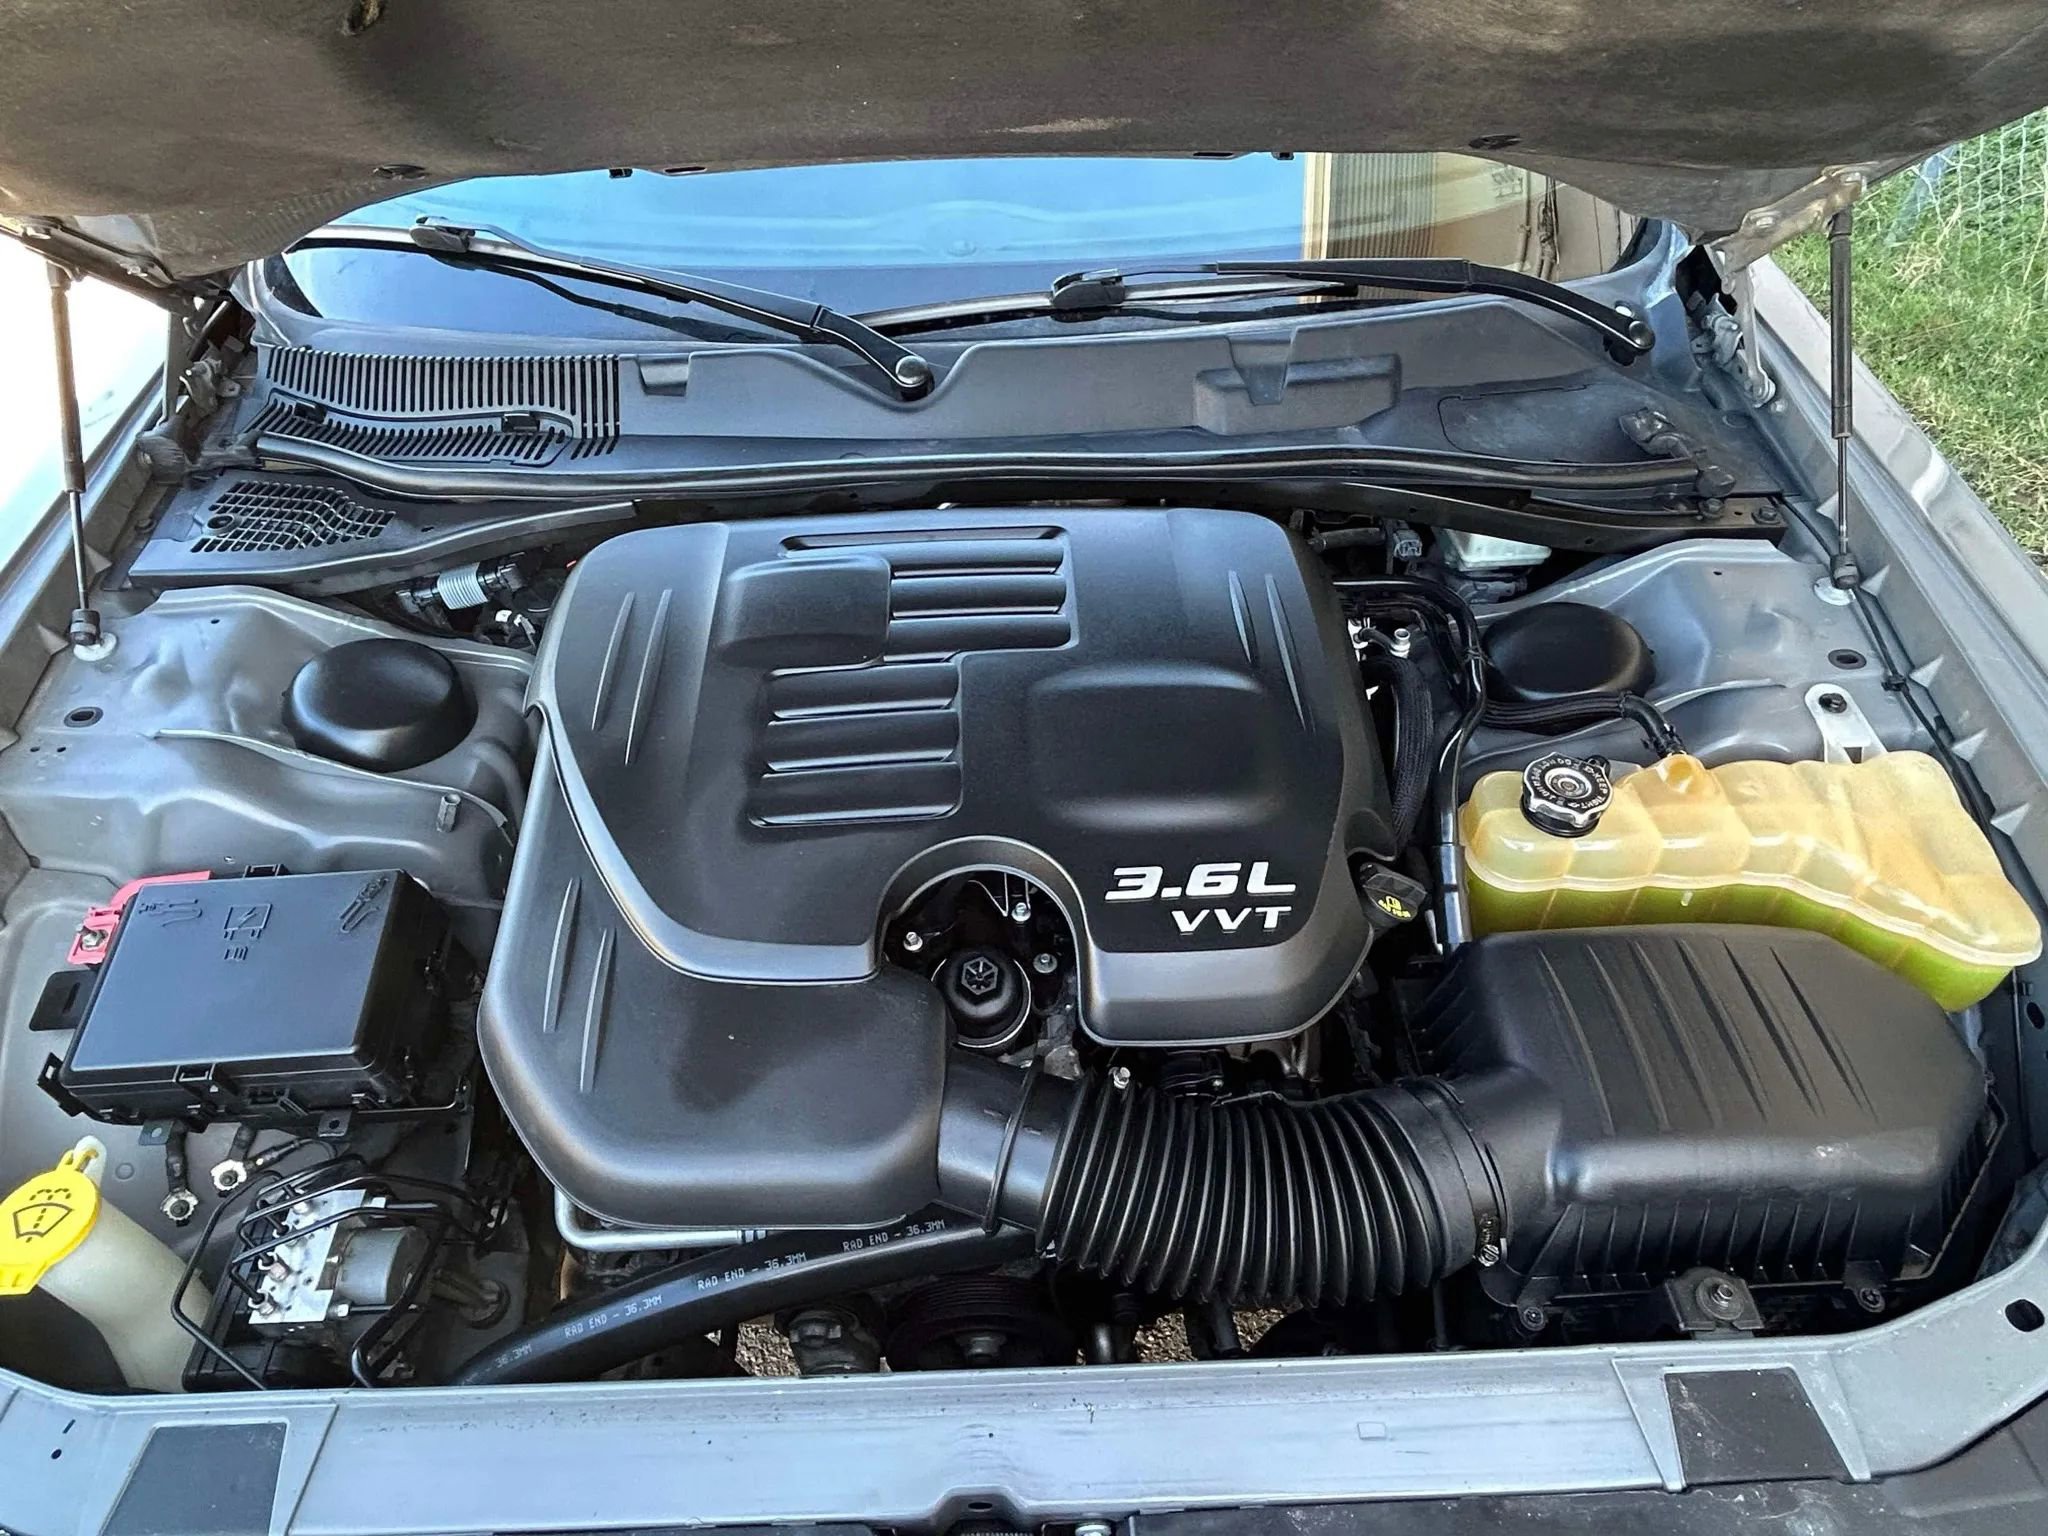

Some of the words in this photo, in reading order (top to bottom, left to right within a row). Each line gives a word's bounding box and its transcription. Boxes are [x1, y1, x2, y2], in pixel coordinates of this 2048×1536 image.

[1593, 771, 1609, 794] KEEP
[1580, 795, 1607, 809] TIGHT
[1104, 861, 1296, 903] 3.6L
[1171, 906, 1292, 935] VVT
[843, 1239, 863, 1252] RAD
[870, 1232, 888, 1245] END
[906, 1220, 945, 1237] 36.3MM
[698, 1278, 718, 1291] RAD
[725, 1269, 745, 1283] END
[764, 1252, 807, 1271] 36.3MM
[564, 1324, 584, 1338] RAD
[589, 1313, 607, 1328] END
[624, 1295, 662, 1317] 36.3MM
